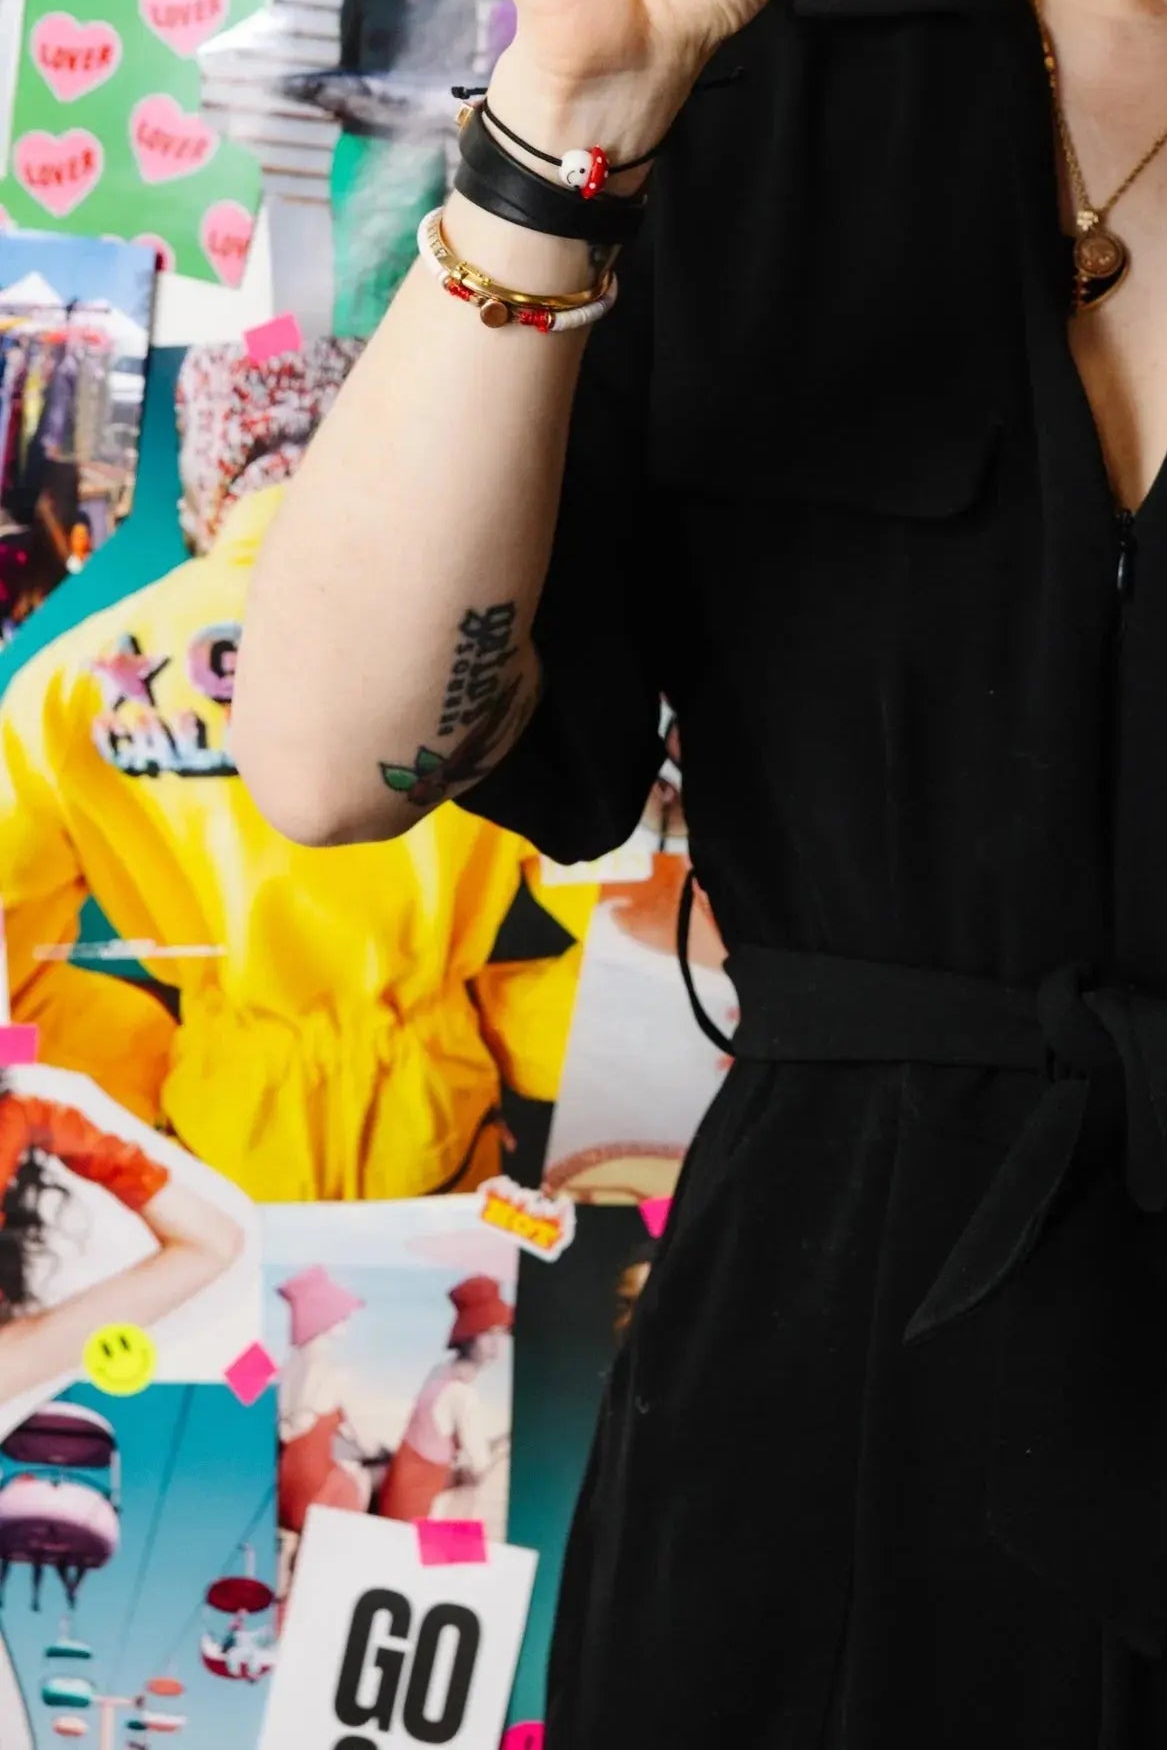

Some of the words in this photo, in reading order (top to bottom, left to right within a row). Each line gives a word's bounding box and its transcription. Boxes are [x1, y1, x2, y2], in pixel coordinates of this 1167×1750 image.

[39, 44, 112, 71] LOVER
[136, 122, 209, 160] LOVER
[25, 147, 94, 186] LOVER
[334, 1588, 482, 1745] GO
